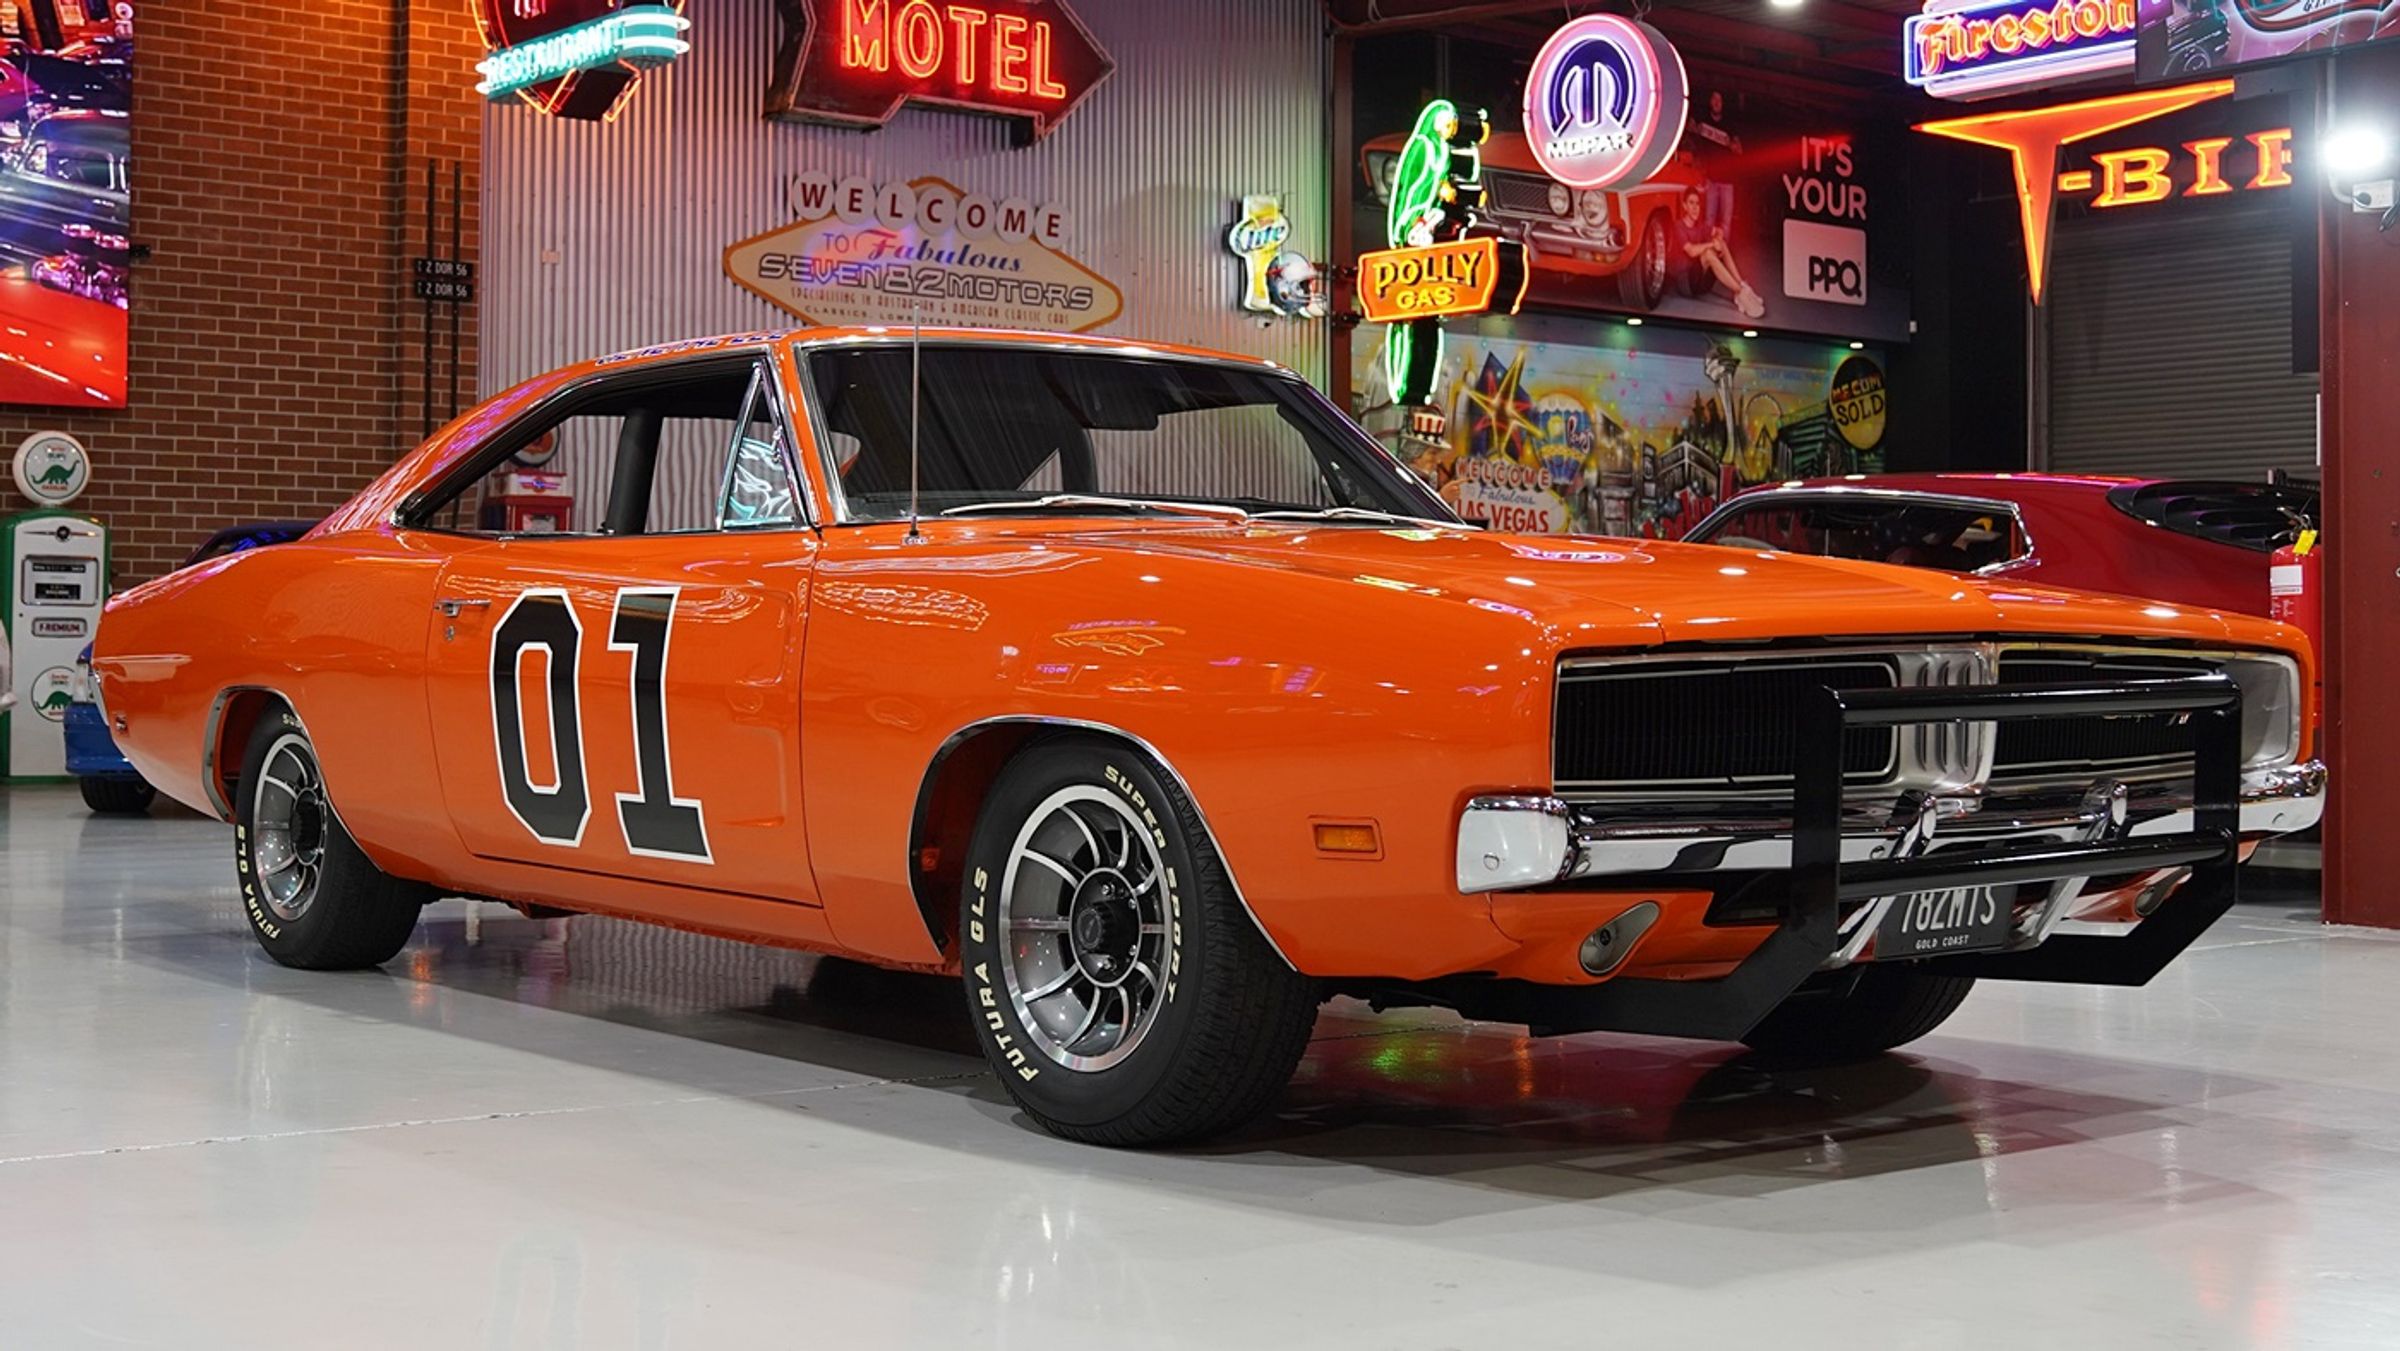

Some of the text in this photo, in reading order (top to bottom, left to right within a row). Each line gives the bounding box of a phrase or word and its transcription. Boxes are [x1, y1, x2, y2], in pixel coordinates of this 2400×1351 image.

[486, 18, 622, 86] RESTAURANT
[841, 0, 1066, 99] MOTEL
[1546, 132, 1635, 159] MOPAR
[1801, 135, 1853, 178] IT'S
[800, 181, 1061, 239] WELCOME
[1783, 173, 1867, 221] YOUR
[823, 229, 1025, 272] TO Fabulous
[1373, 250, 1483, 298] POLLY
[1809, 255, 1863, 298] PPQ
[880, 313, 950, 325] LOWRDERS
[1396, 286, 1455, 309] GAS
[1836, 394, 1884, 426] SOLD
[1457, 460, 1549, 486] WELCOME
[1457, 498, 1549, 533] LAS VEGAS
[489, 585, 715, 866] 01
[1104, 764, 1182, 1004] SUPER SPORT
[244, 883, 281, 940] FUTURA
[1916, 934, 1970, 950] GOLD COAST
[969, 866, 1040, 1082] FUTURA GLS
